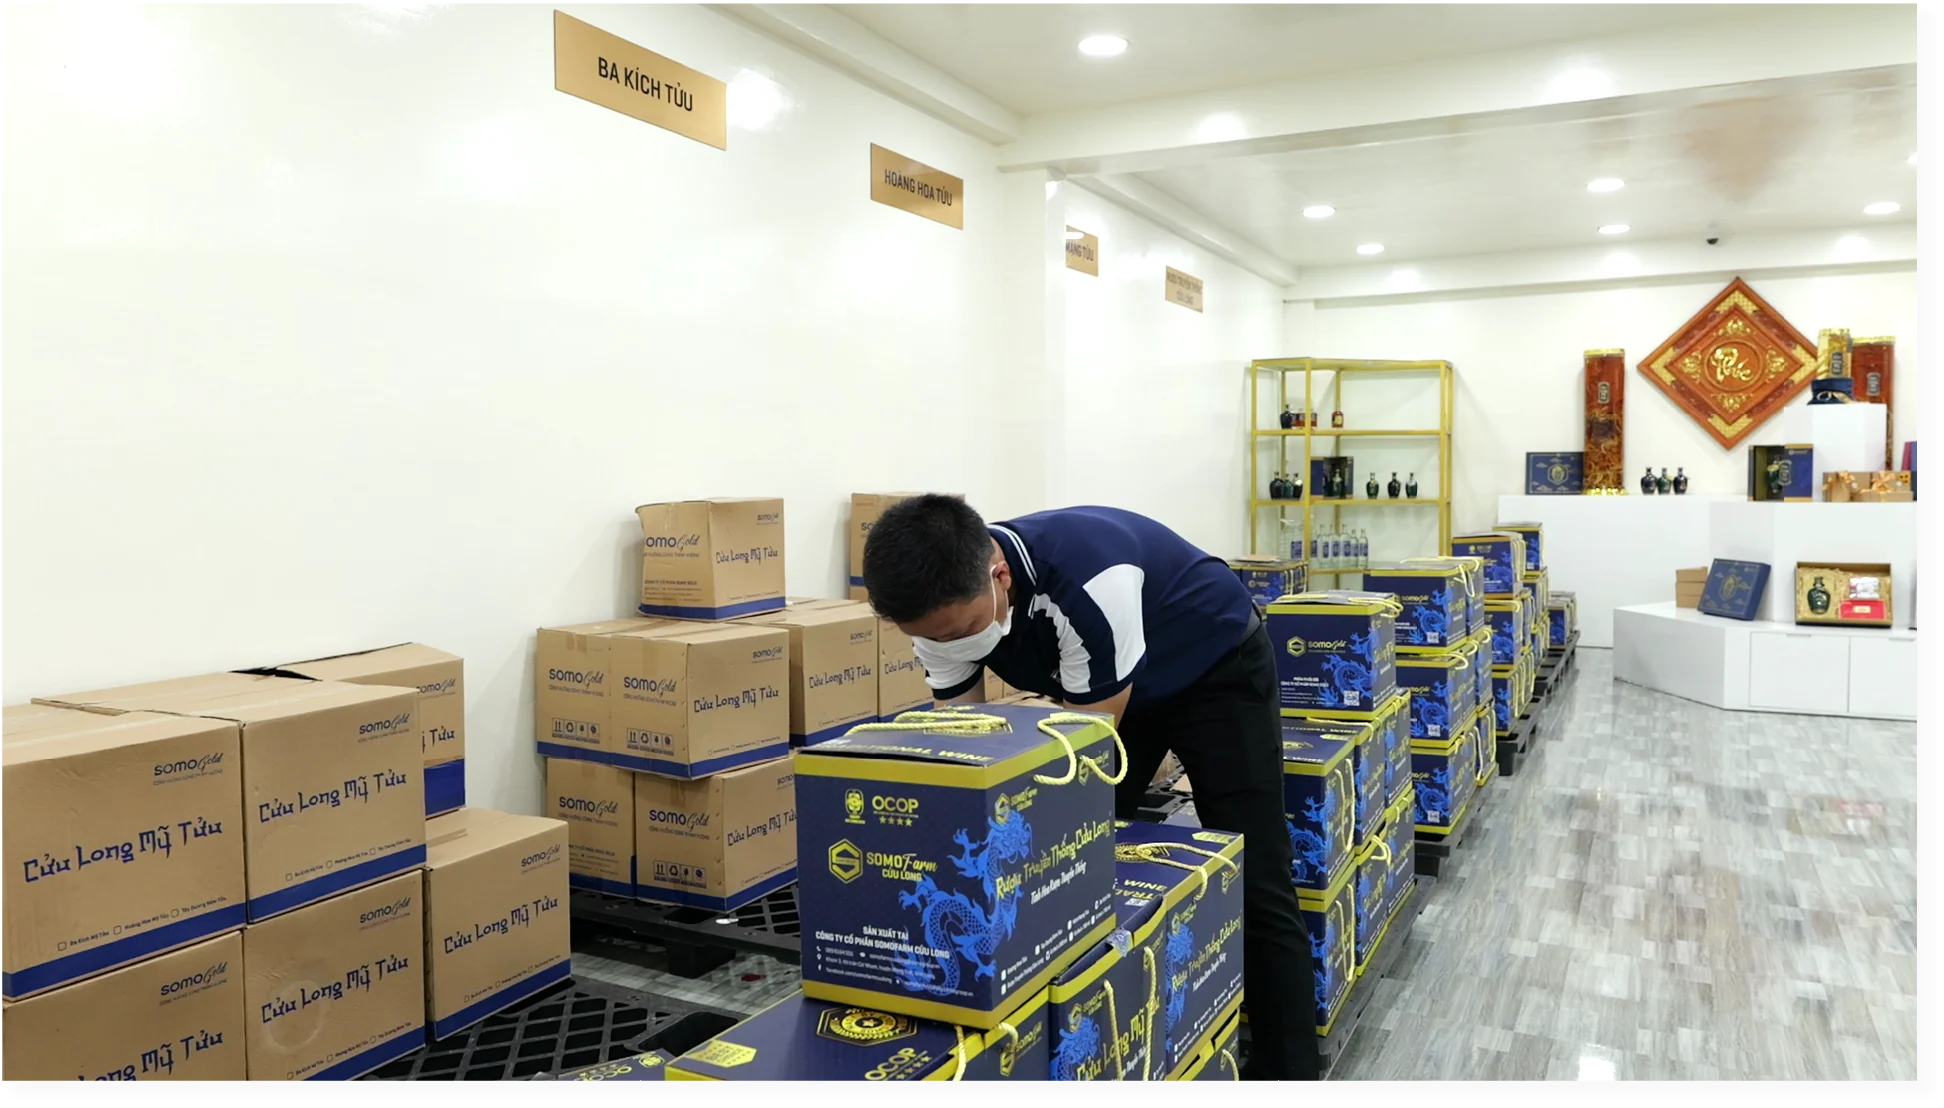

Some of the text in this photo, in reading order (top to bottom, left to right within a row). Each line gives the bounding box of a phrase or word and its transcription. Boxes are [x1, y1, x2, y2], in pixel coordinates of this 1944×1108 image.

[598, 56, 620, 84] BA
[624, 67, 661, 100] KÍCH
[917, 181, 935, 200] HOA
[730, 549, 750, 564] Long
[715, 694, 740, 709] Long
[938, 749, 996, 763] WINE
[259, 769, 407, 823] Cửu Long Mỹ Tửu
[871, 795, 919, 813] OCOP
[746, 825, 767, 839] Long
[1092, 820, 1110, 842] Long
[23, 816, 223, 883] Cửu Long Mỹ Tửu
[900, 870, 923, 882] LONG
[1124, 879, 1168, 892] WINE
[443, 895, 558, 954] Cửu Long Mỹ Tửu
[815, 930, 835, 941] CÔNG
[835, 934, 844, 943] TY
[874, 940, 914, 954] SOMOFARM
[930, 949, 950, 959] LONG
[261, 954, 409, 1023] Cửu Long Mỹ Tửu
[141, 1042, 174, 1075] Mỹ
[180, 1030, 223, 1061] Tửu
[864, 1047, 916, 1081] OCOP
